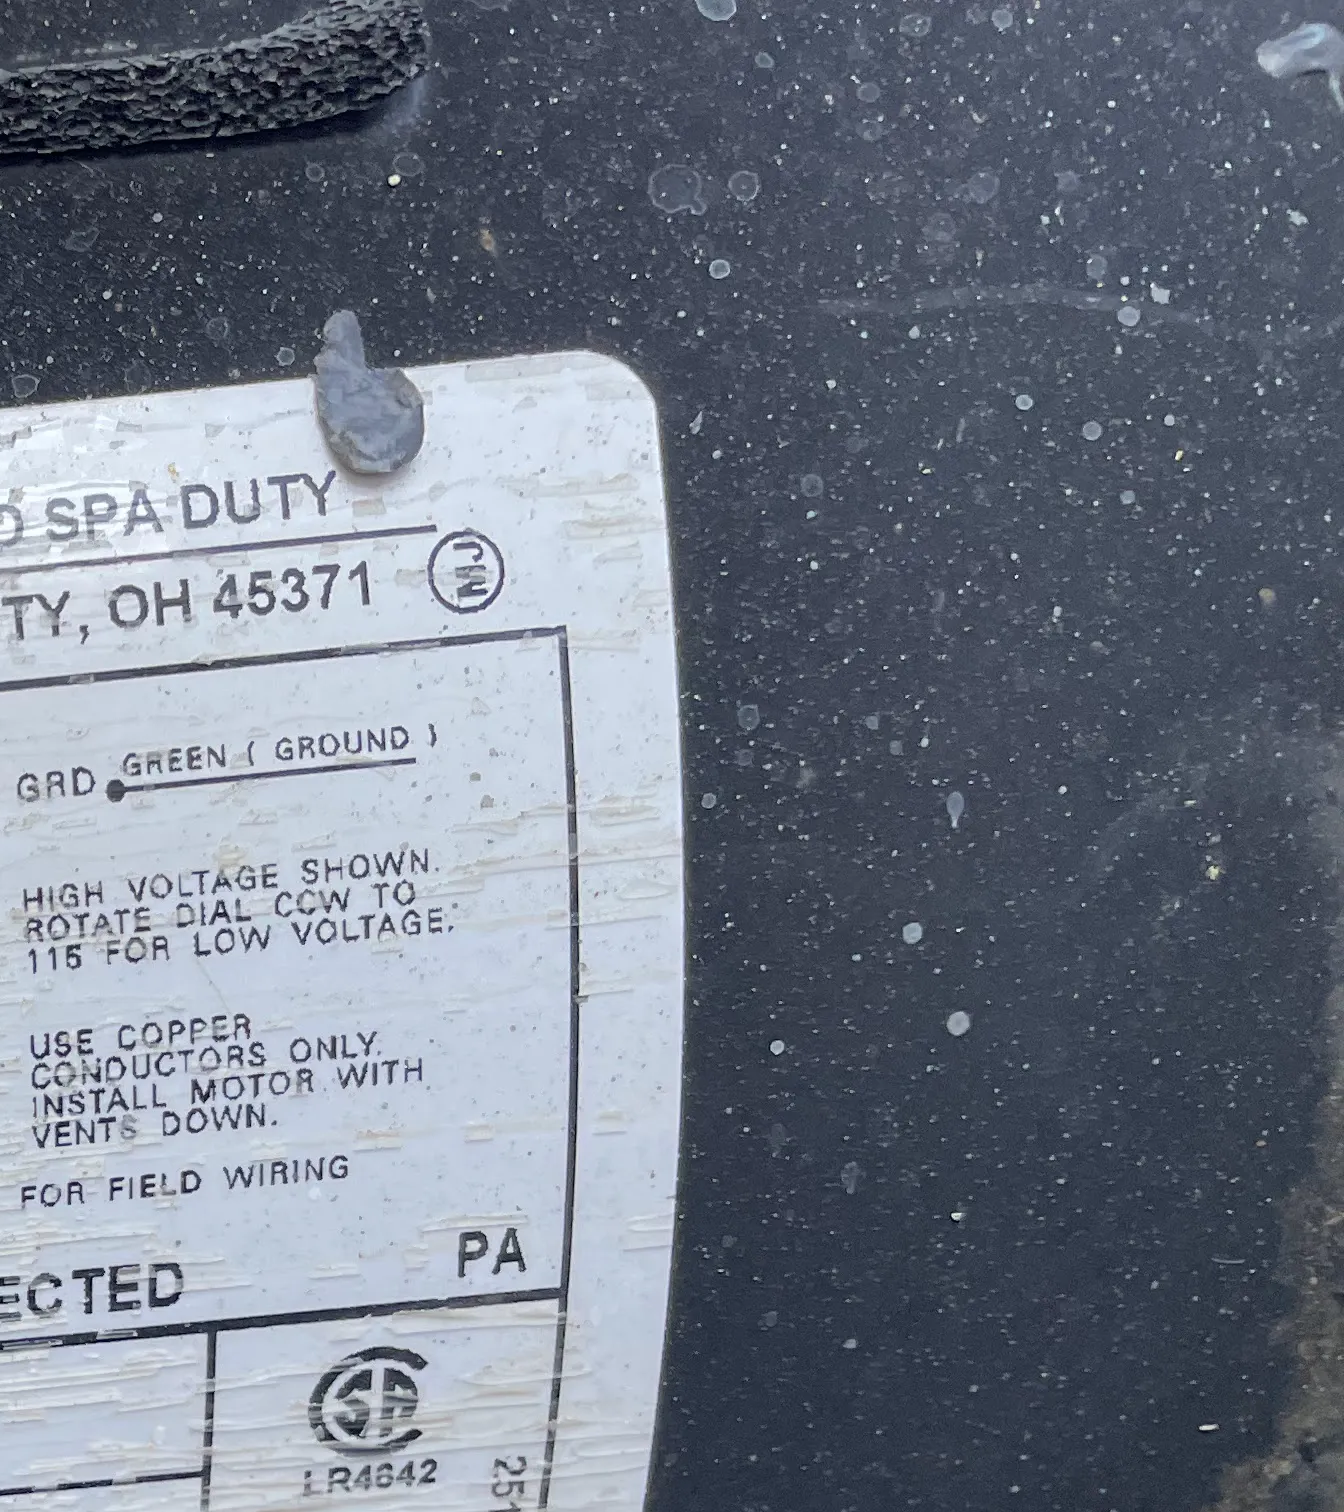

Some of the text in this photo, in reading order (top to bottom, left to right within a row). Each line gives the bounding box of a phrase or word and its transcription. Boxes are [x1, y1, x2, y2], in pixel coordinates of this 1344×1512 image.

[45, 491, 165, 542] SPA
[180, 470, 340, 530] DUTY
[107, 578, 193, 629] OH
[211, 560, 374, 619] 45371
[16, 766, 97, 803] GRD
[121, 743, 243, 777] GREEN
[274, 726, 410, 762] GROUND
[22, 847, 441, 914] HIGH VOLTAGE SHOWN.
[24, 906, 153, 944] ROTATE
[176, 897, 253, 929] DIAL
[372, 879, 417, 909] TO
[27, 943, 84, 975] 115
[106, 935, 171, 966] FOR
[193, 923, 273, 958] LOW
[28, 1013, 253, 1061] USE COPPER
[30, 1030, 383, 1091] CONDUCTORS ONLY.
[31, 1057, 424, 1119] INSTALL MOTOR WITH
[31, 1102, 279, 1151] VENTS DOWN.
[19, 1180, 87, 1211] FOR
[107, 1168, 203, 1202] FIELD
[221, 1154, 351, 1191] WIRING
[456, 1227, 528, 1278] PA
